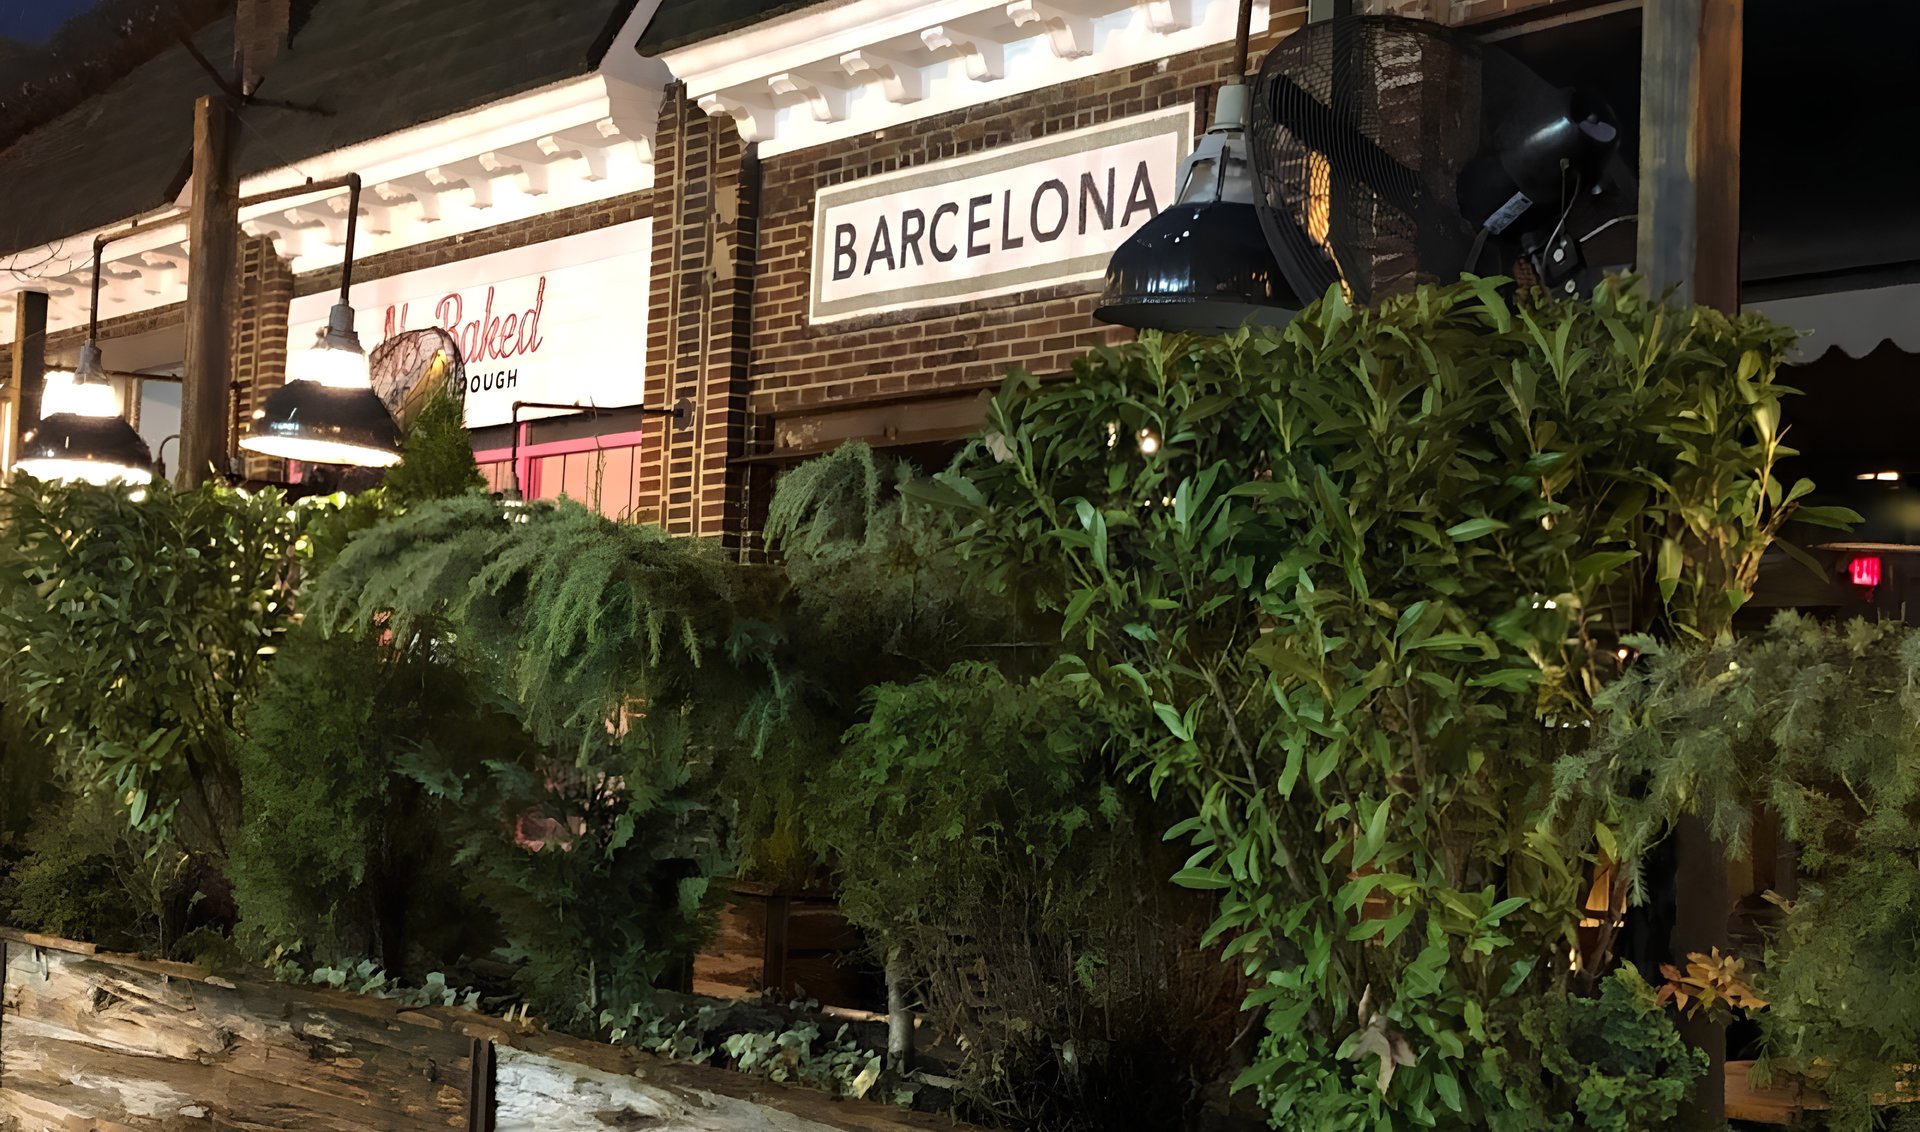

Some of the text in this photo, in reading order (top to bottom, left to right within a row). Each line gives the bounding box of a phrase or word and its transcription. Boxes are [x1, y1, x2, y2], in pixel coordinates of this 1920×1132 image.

[831, 160, 1159, 282] BARCELONA
[435, 275, 546, 366] Baked
[463, 368, 518, 393] OUGH
